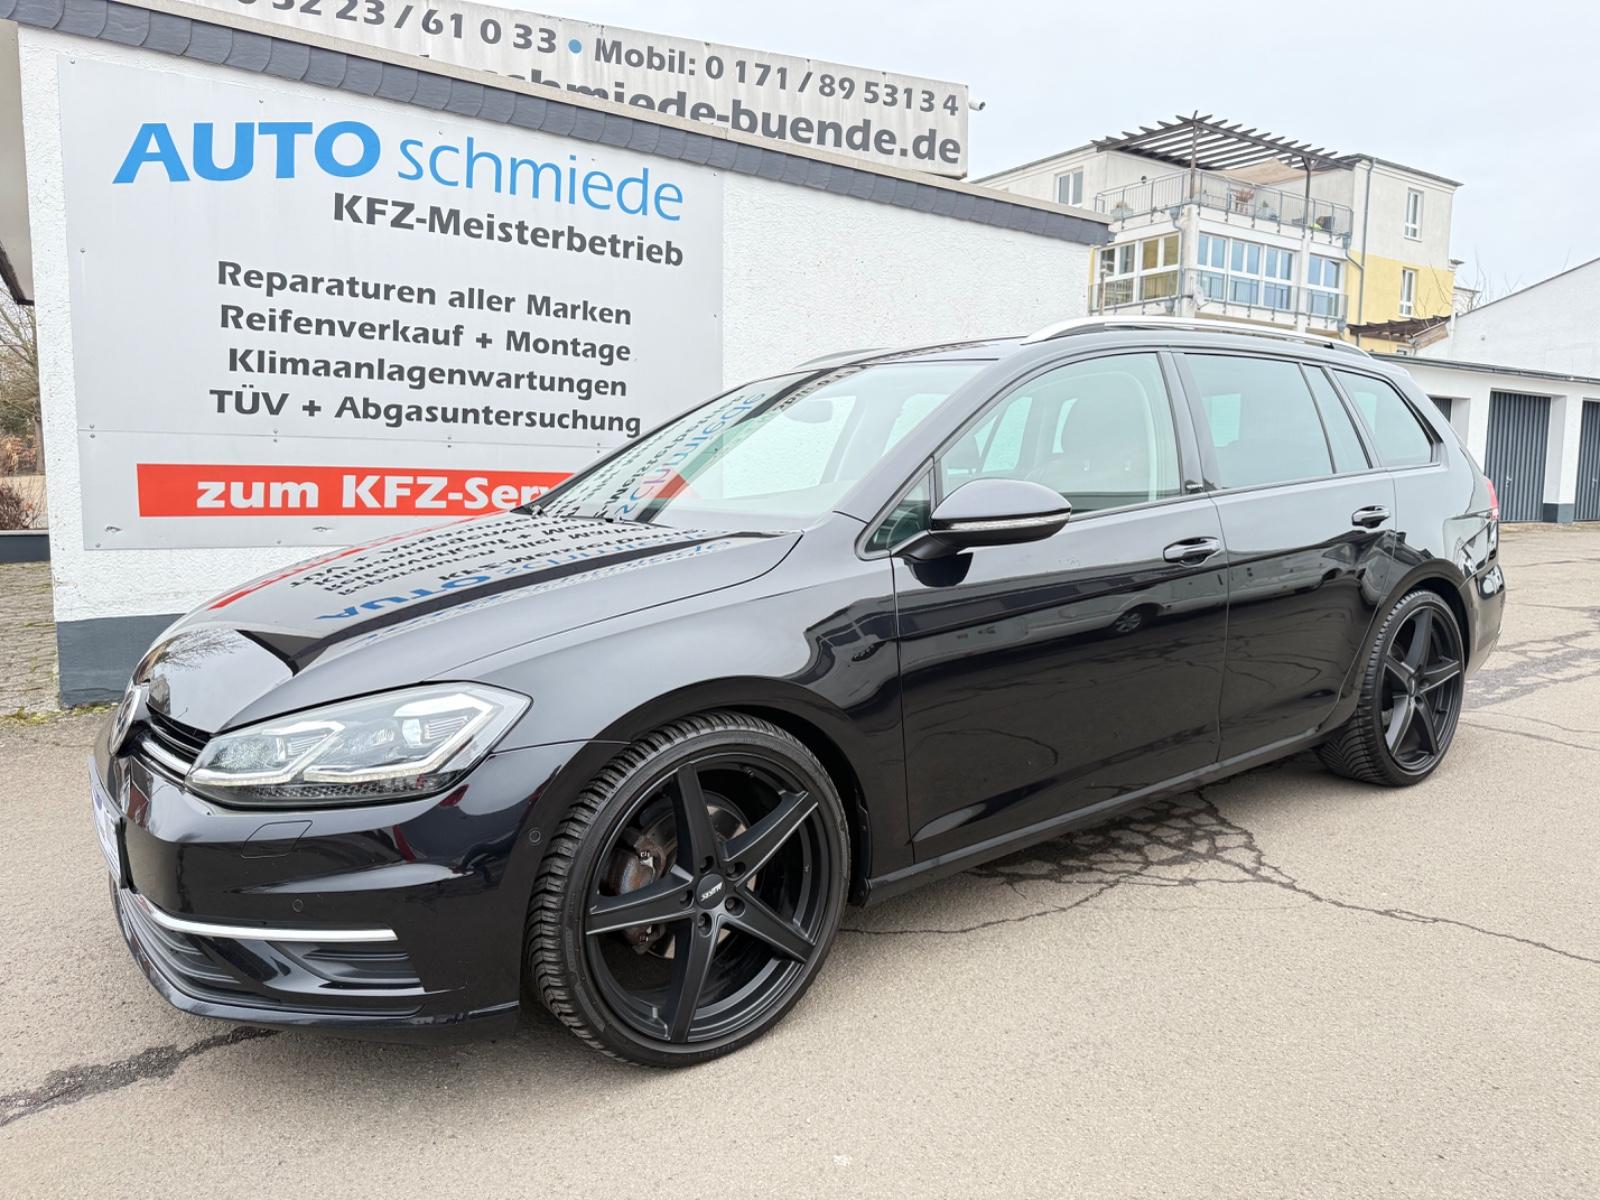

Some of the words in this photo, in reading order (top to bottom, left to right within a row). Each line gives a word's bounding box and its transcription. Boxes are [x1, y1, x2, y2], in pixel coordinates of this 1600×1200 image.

[513, 24, 557, 54] 33
[594, 38, 697, 77] Mobil:
[113, 121, 382, 184] AUTO
[398, 136, 684, 222] schmiede
[334, 192, 683, 266] KFZ-Meisterbetrieb
[218, 260, 436, 305] Reparaturen
[448, 287, 516, 313] aller
[527, 294, 631, 325] Marken
[220, 304, 465, 347] Reifenverkauf
[475, 332, 493, 349] +
[506, 330, 631, 367] Montage
[229, 348, 627, 401] Klimaanlagenwartungen
[209, 383, 290, 416] TÜV
[302, 399, 322, 417] +
[334, 396, 641, 439] Abgasuntersuchung
[196, 481, 319, 509] zum
